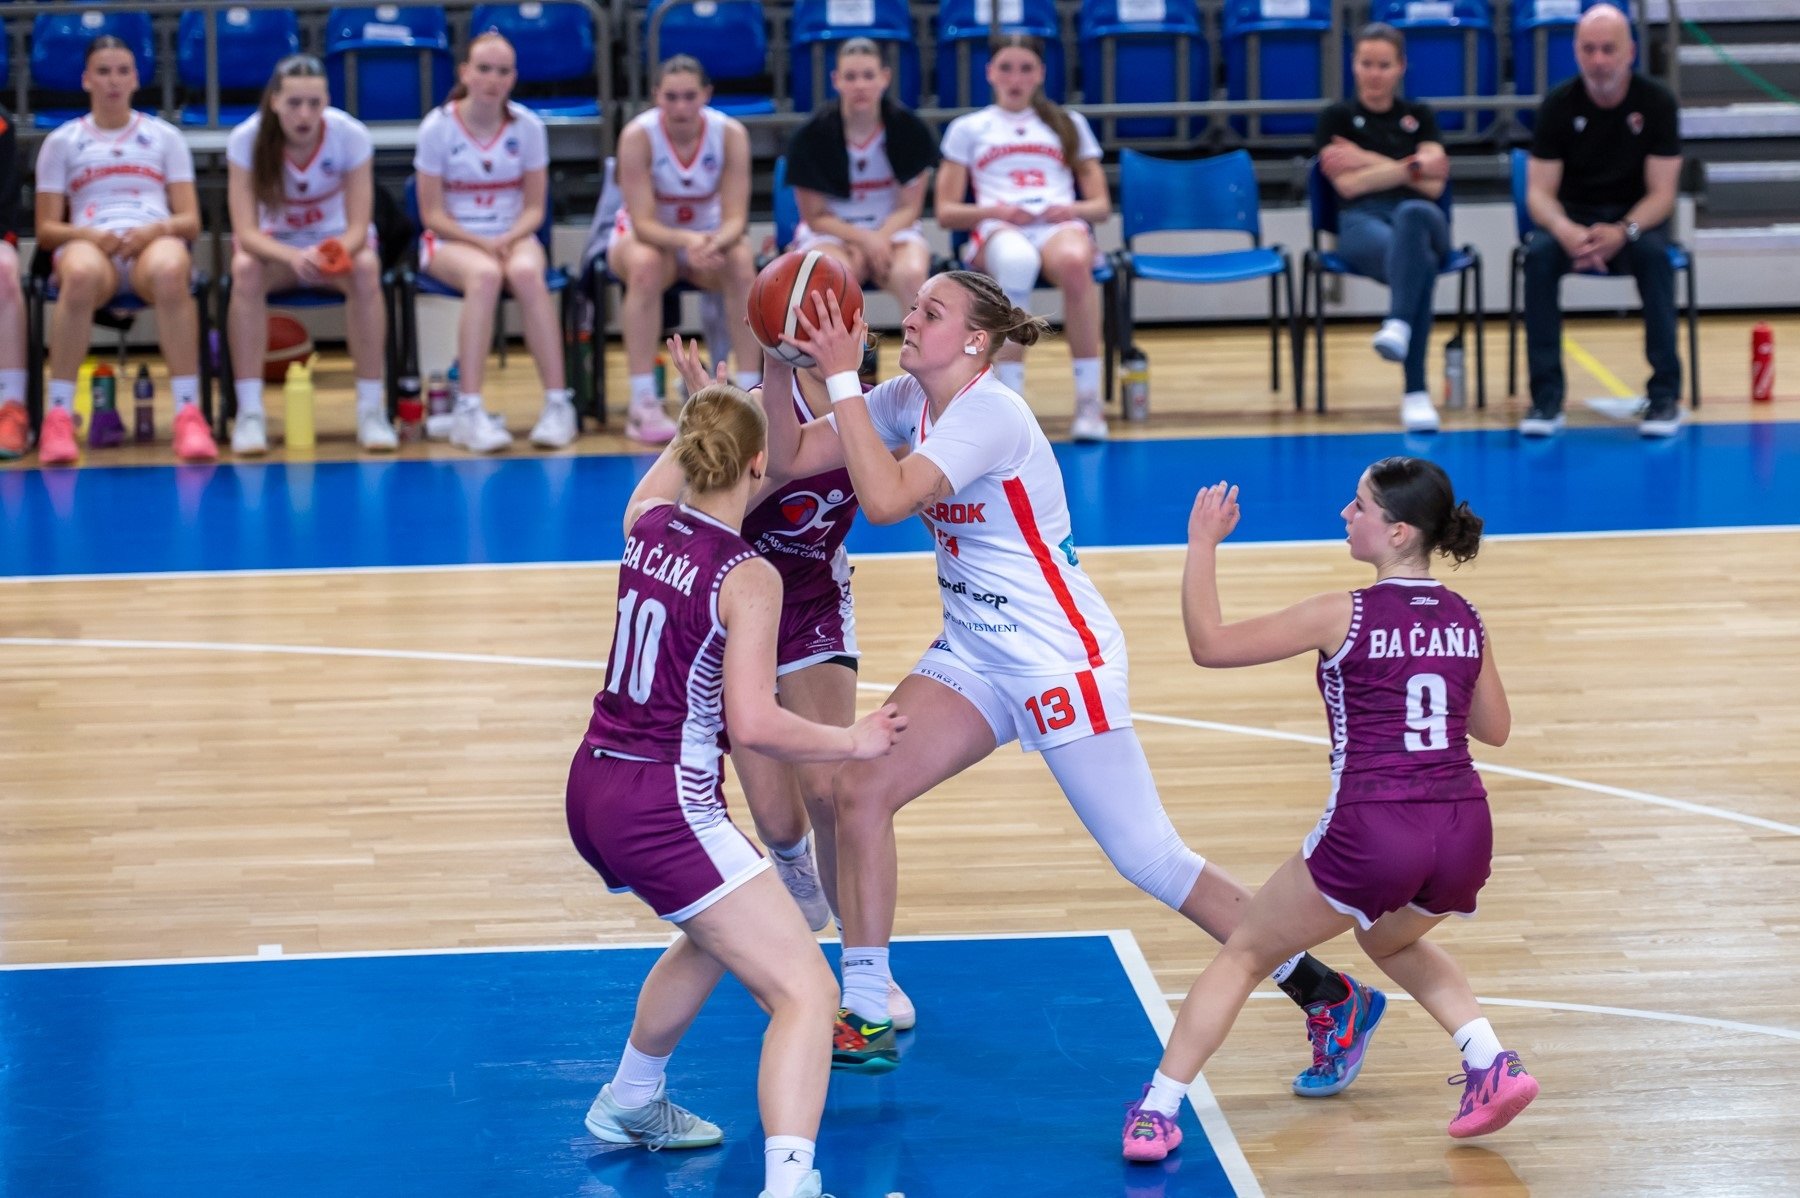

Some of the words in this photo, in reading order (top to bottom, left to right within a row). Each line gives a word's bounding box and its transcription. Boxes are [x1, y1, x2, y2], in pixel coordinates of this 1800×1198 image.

[642, 542, 700, 597] ČAŇA
[606, 588, 667, 705] 10
[1409, 622, 1480, 658] ČAŇA
[1024, 686, 1076, 735] 13
[1404, 673, 1449, 752] 9
